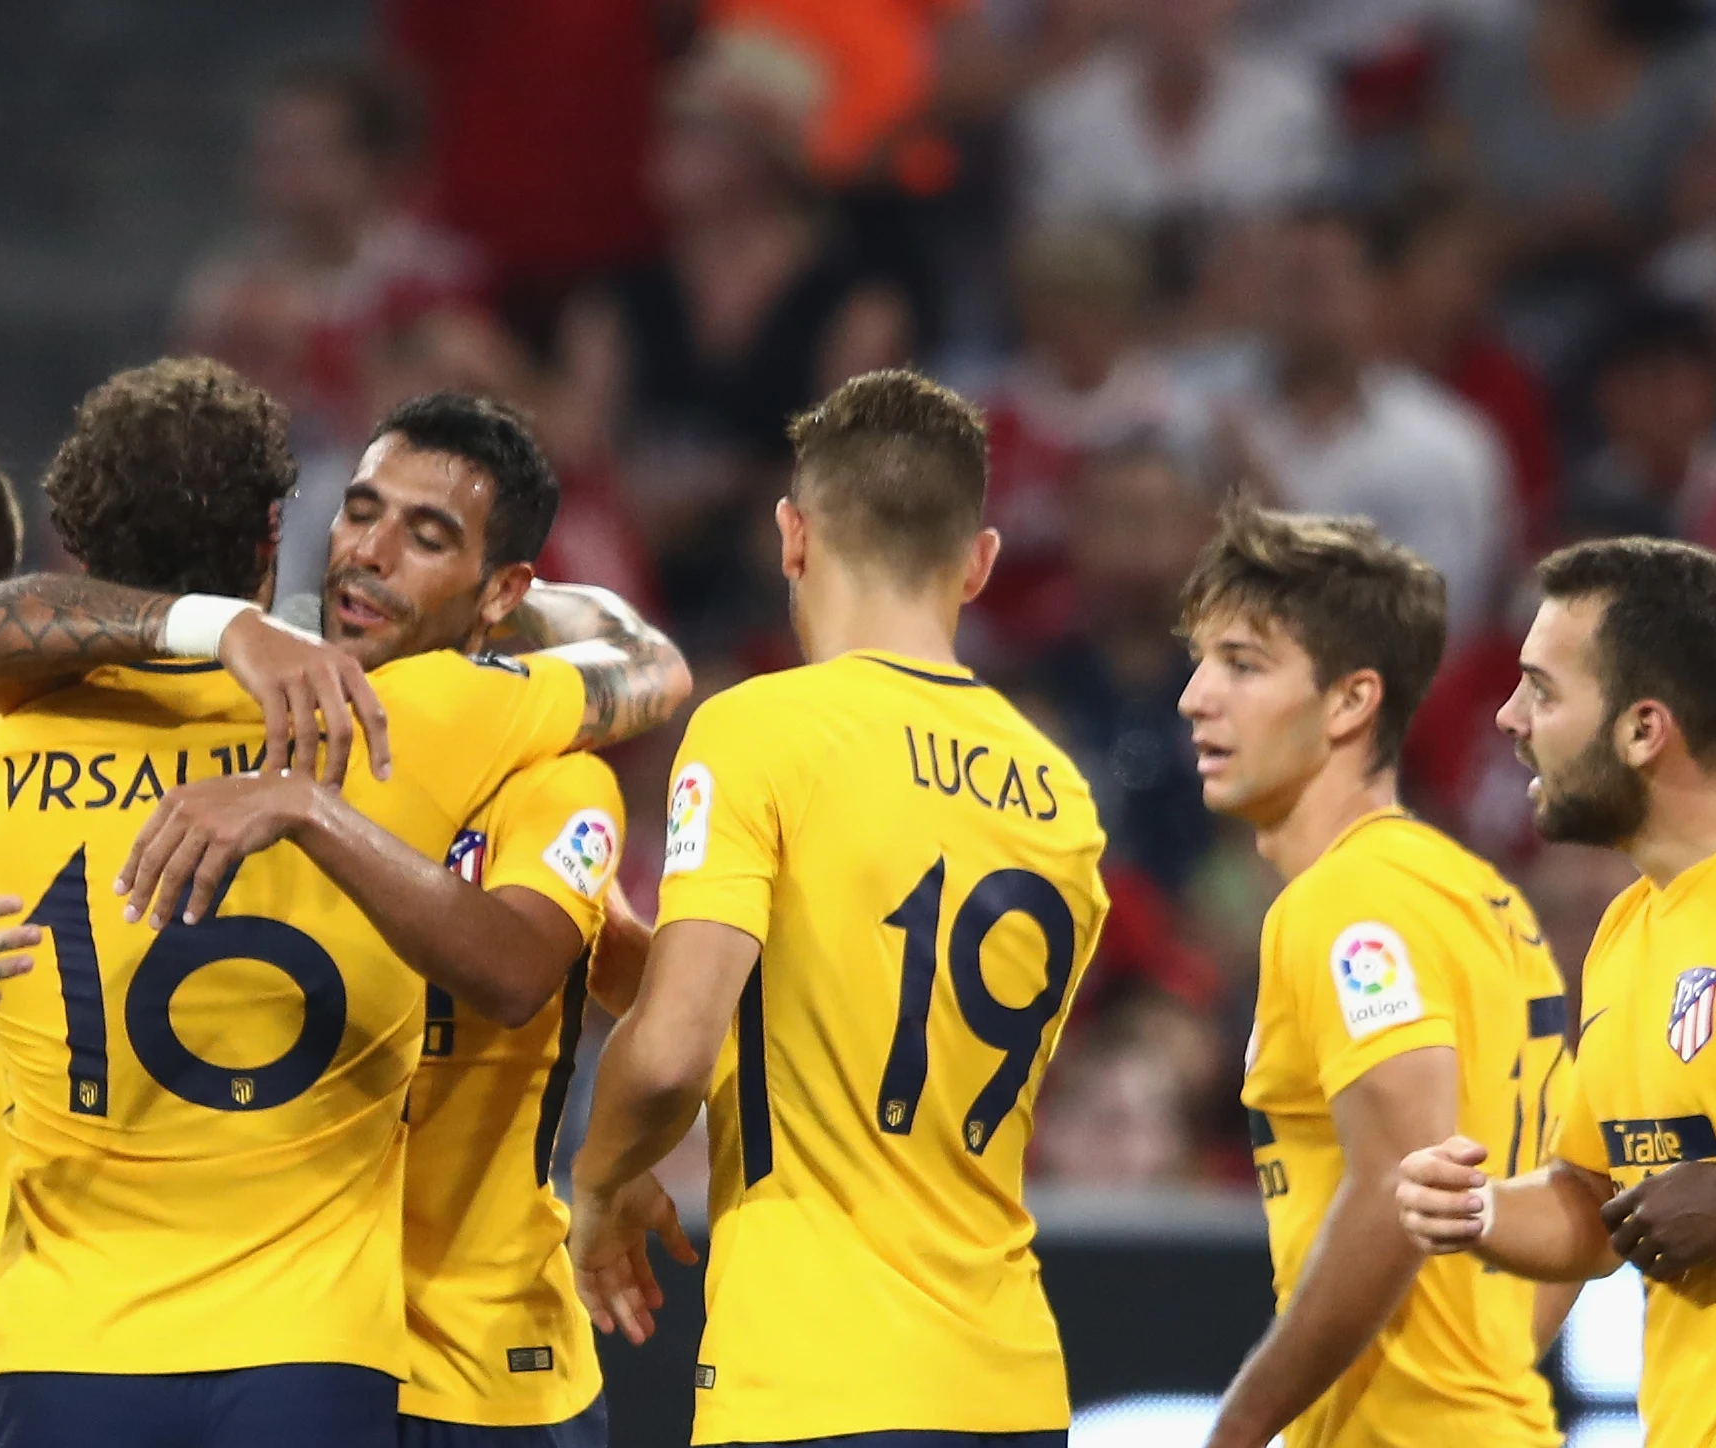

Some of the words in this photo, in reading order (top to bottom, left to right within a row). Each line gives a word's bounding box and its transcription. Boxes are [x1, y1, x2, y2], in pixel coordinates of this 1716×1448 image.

[905, 726, 1057, 821] LUCAS
[554, 847, 589, 898] LaLig
[22, 840, 347, 1117] 16
[877, 853, 1076, 1157] 19
[1613, 1121, 1682, 1163] Trade
